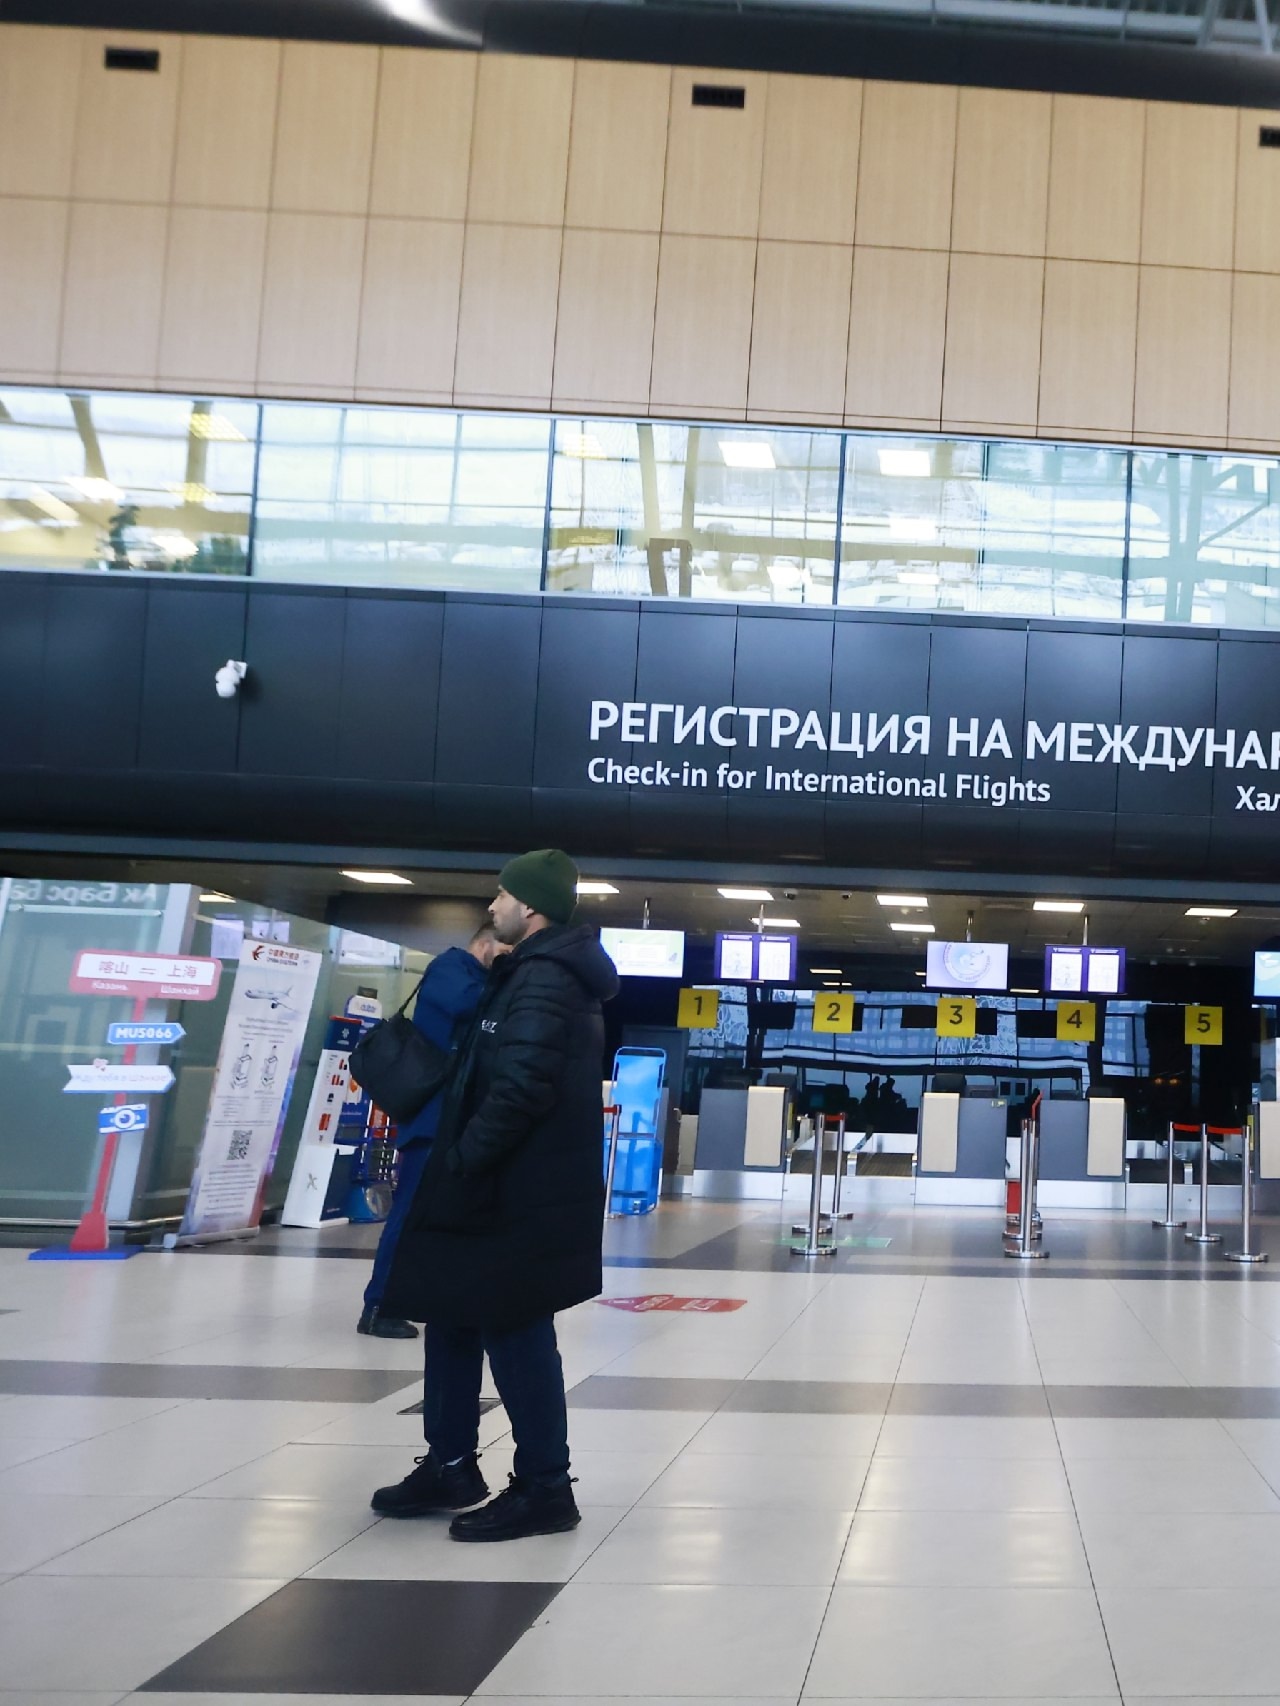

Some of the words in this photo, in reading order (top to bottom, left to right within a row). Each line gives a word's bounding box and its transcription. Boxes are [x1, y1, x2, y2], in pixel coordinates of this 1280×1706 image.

[589, 700, 932, 759] РЕГИСТРАЦИЯ
[947, 717, 1012, 759] НА
[587, 757, 708, 787] Check-in
[716, 762, 757, 789] for
[765, 765, 947, 798] International
[955, 773, 1051, 807] Flights
[167, 963, 198, 978] 上海
[694, 995, 704, 1017] 1
[826, 1001, 841, 1022] 2
[949, 1004, 963, 1025] 3
[1066, 1009, 1083, 1029] 4
[1197, 1012, 1211, 1033] 5
[115, 1027, 172, 1039] MU5066
